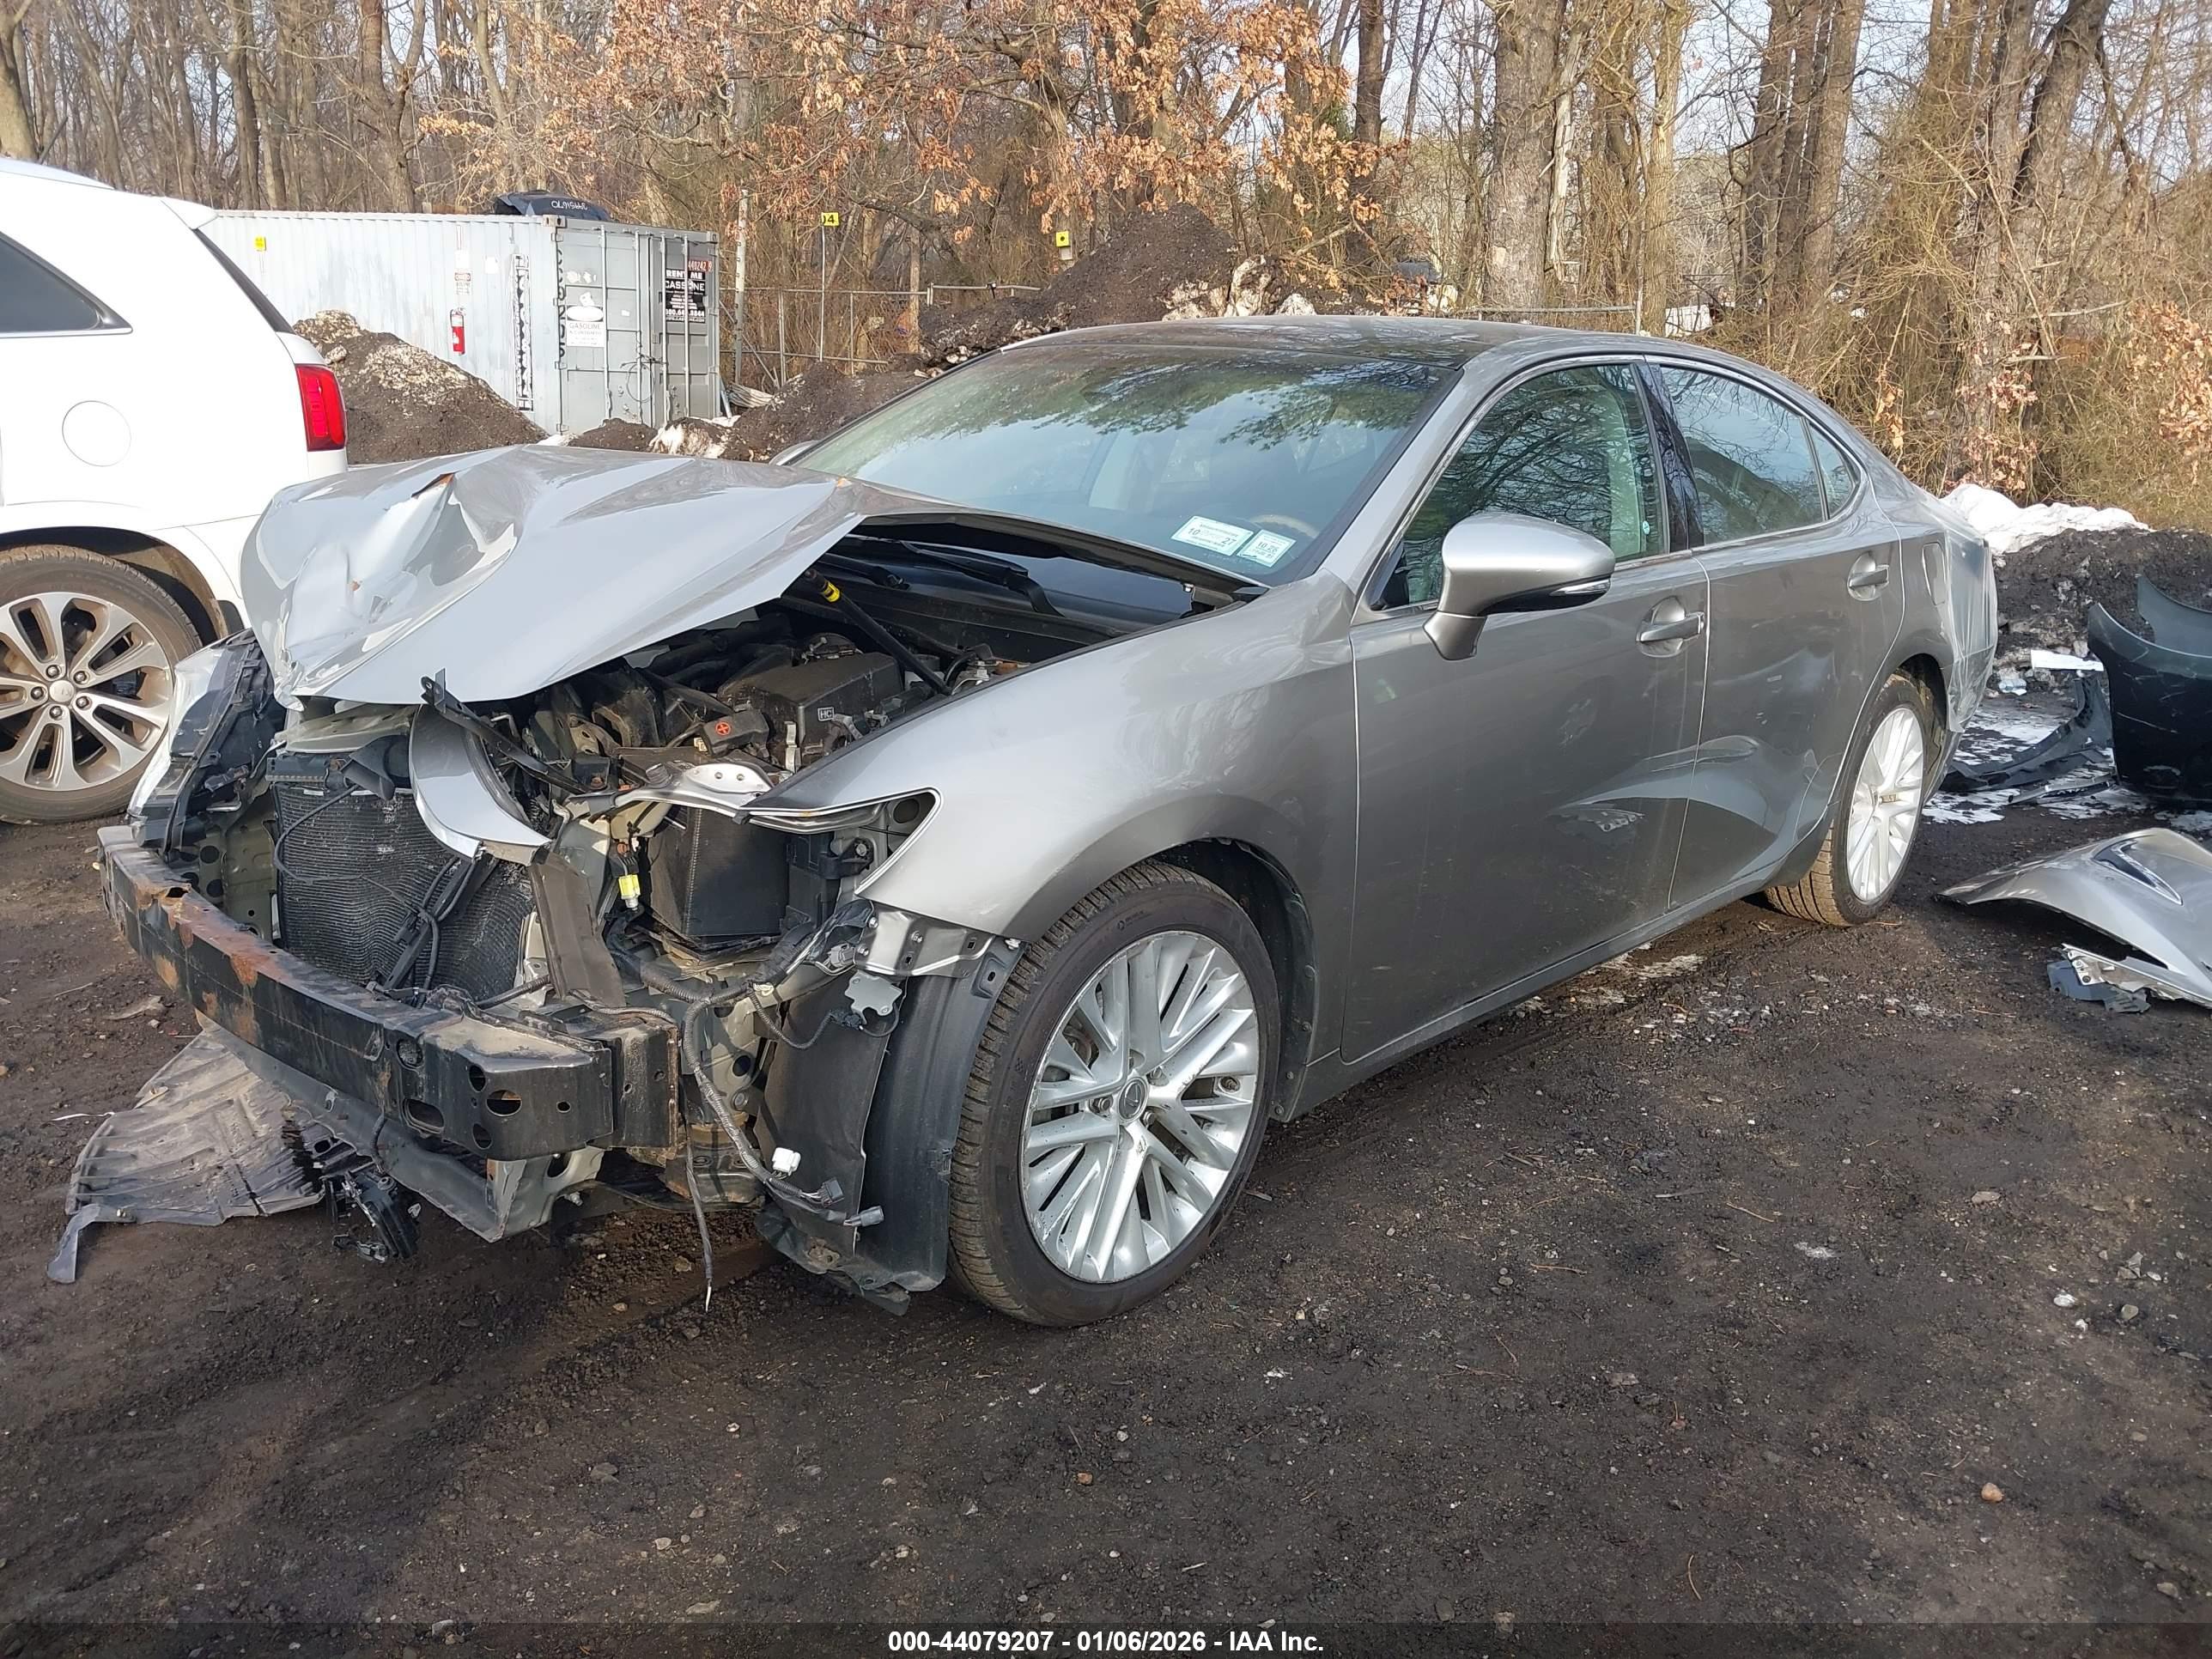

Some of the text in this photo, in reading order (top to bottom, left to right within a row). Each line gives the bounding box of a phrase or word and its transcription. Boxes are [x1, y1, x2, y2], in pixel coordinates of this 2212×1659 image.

[665, 269, 703, 280] RENT ME
[1188, 527, 1201, 536] 10
[1221, 537, 1237, 546] 27
[820, 709, 832, 719] HC
